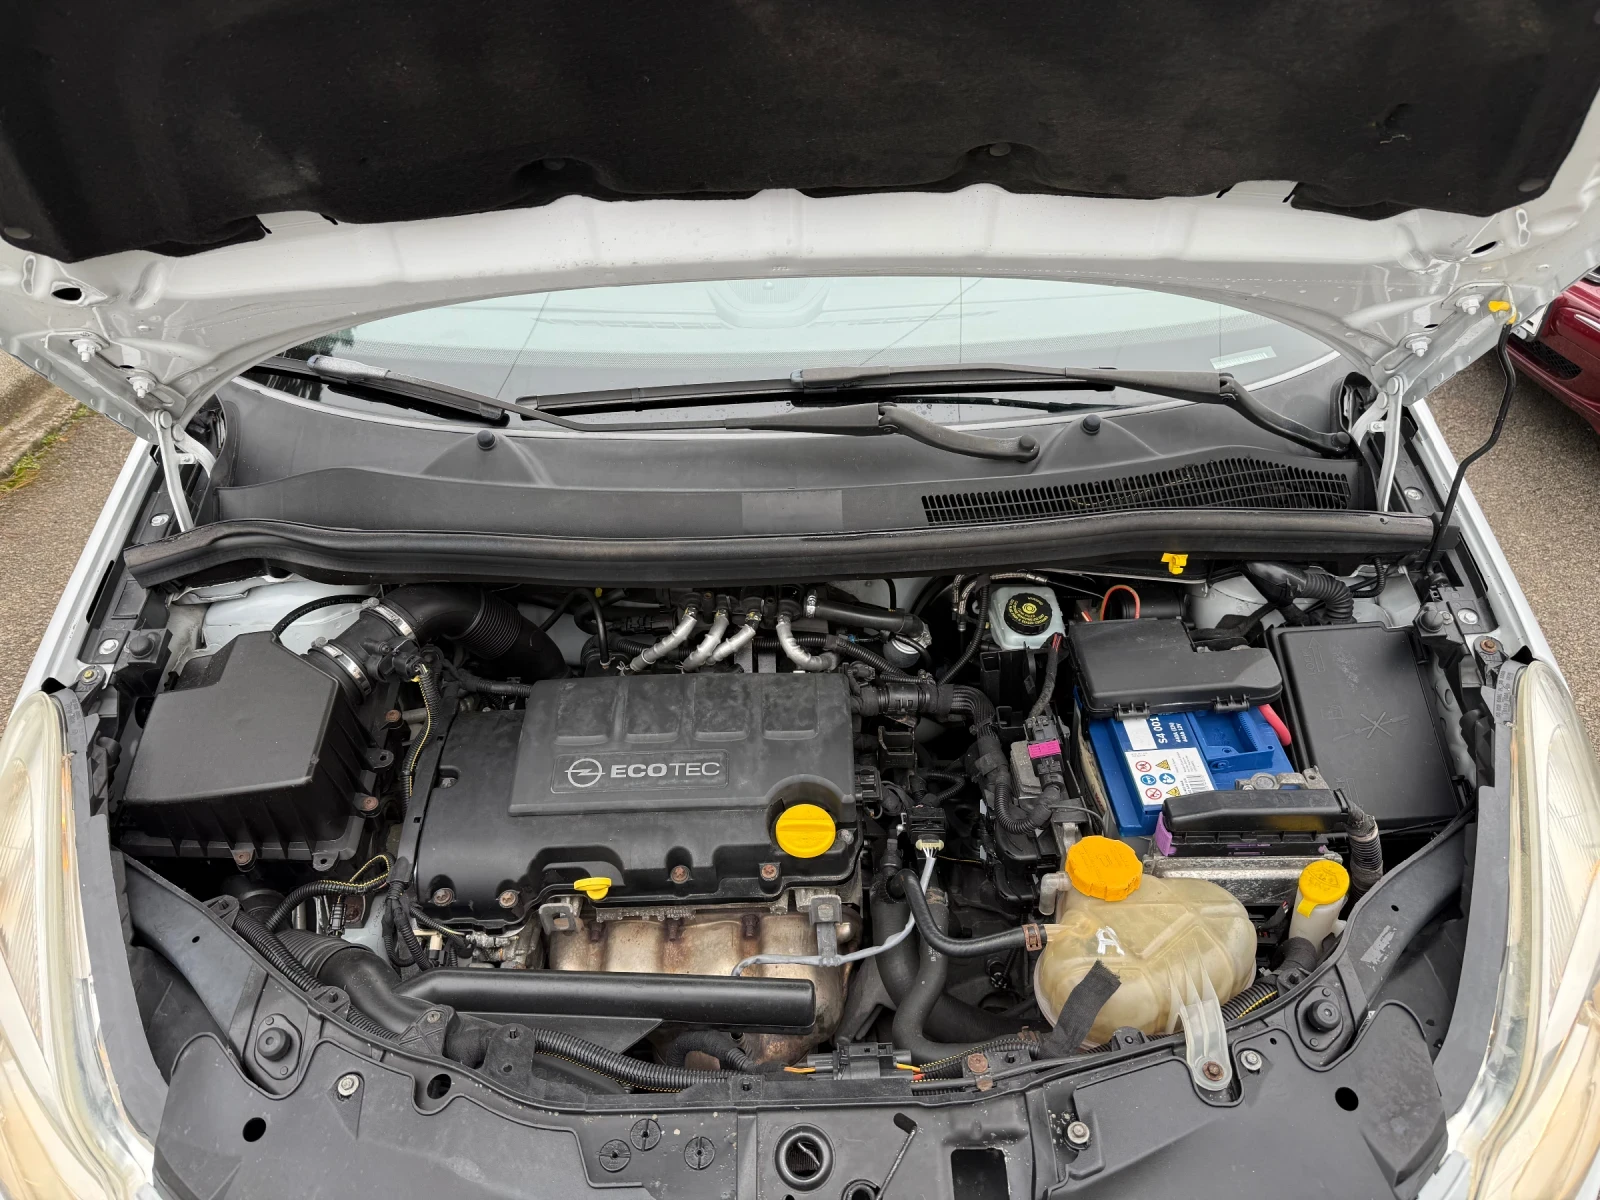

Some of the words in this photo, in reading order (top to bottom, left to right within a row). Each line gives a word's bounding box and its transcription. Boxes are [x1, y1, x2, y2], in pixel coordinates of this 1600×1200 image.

[1302, 649, 1317, 675] LOCK
[1150, 716, 1163, 732] 001
[1155, 733, 1168, 744] S4
[610, 761, 720, 779] ECOTEC
